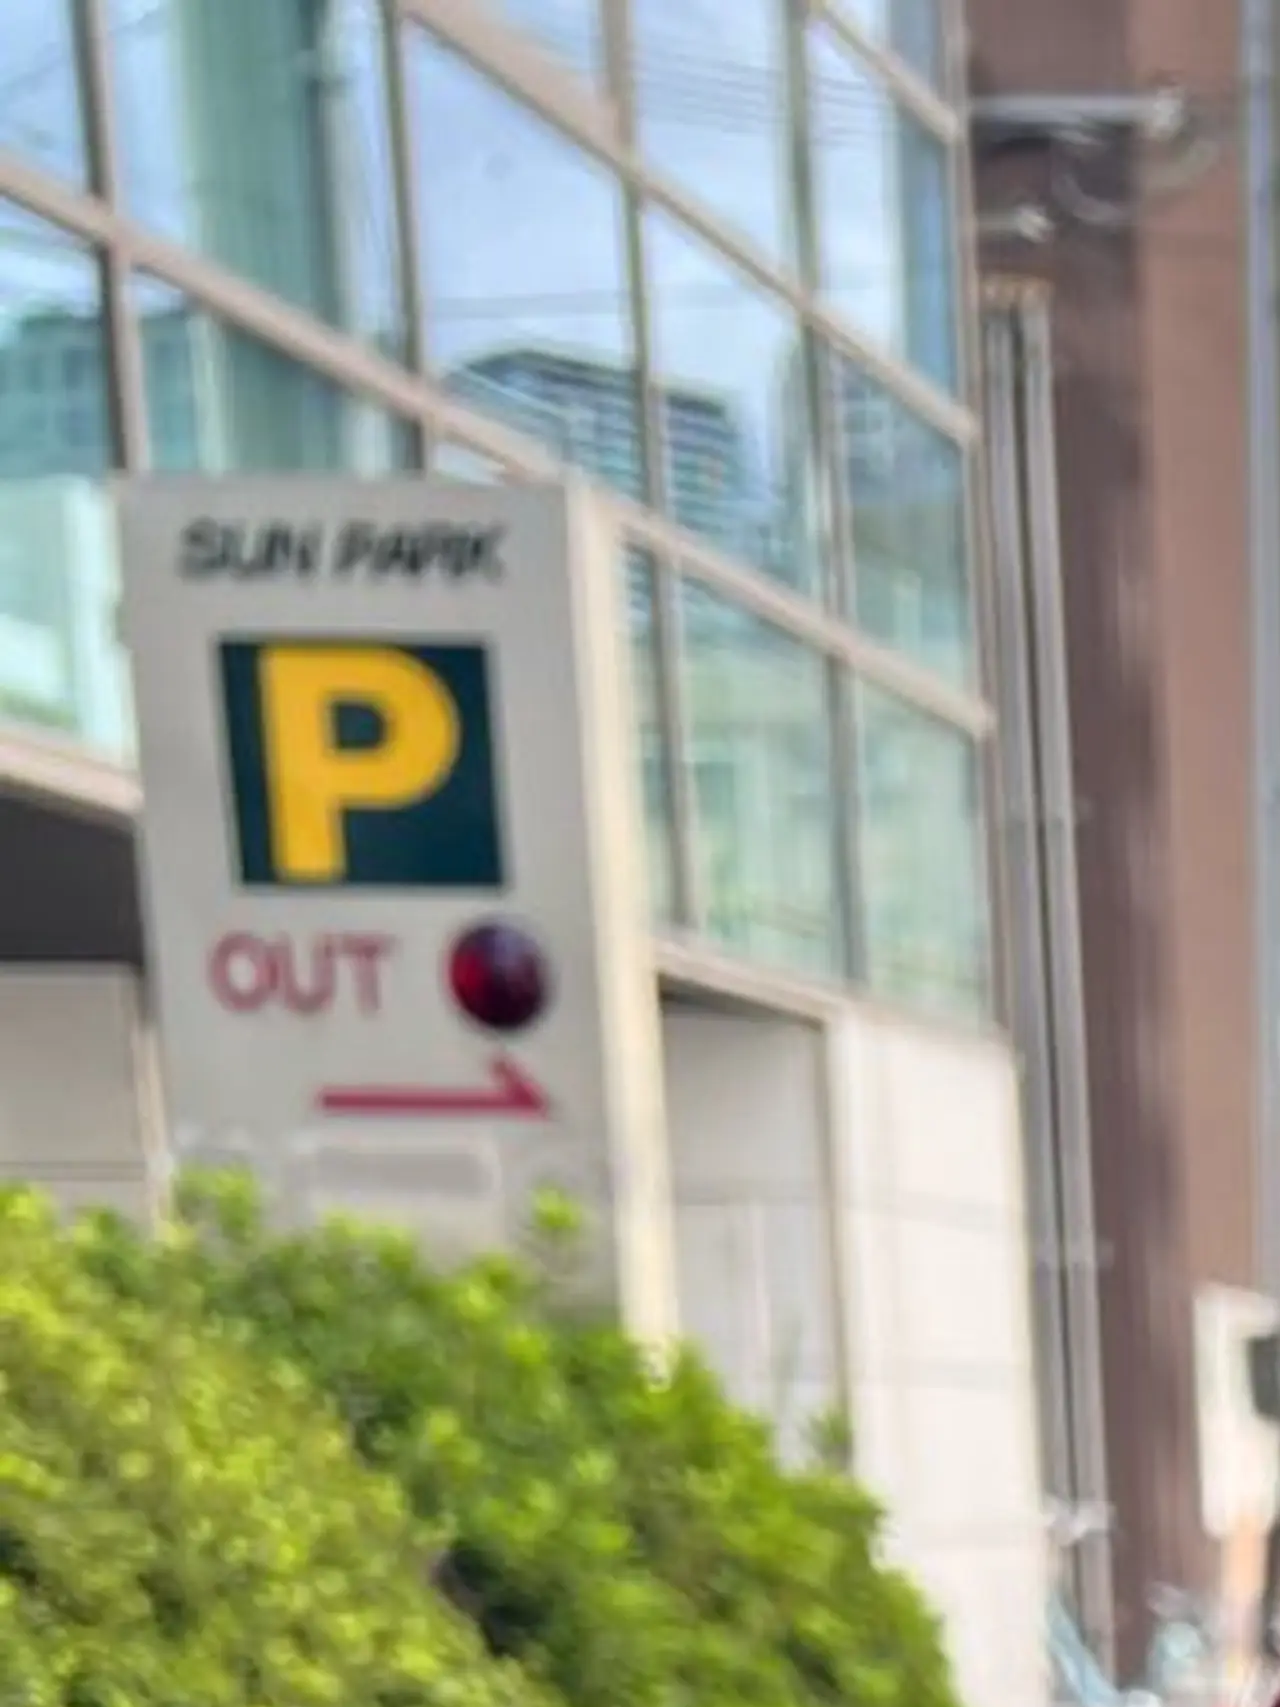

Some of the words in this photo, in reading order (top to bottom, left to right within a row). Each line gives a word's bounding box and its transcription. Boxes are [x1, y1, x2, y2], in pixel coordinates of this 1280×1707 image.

[178, 517, 324, 580] SUN
[333, 517, 505, 580] PARK
[258, 644, 462, 884] P
[210, 932, 396, 1014] OUT
